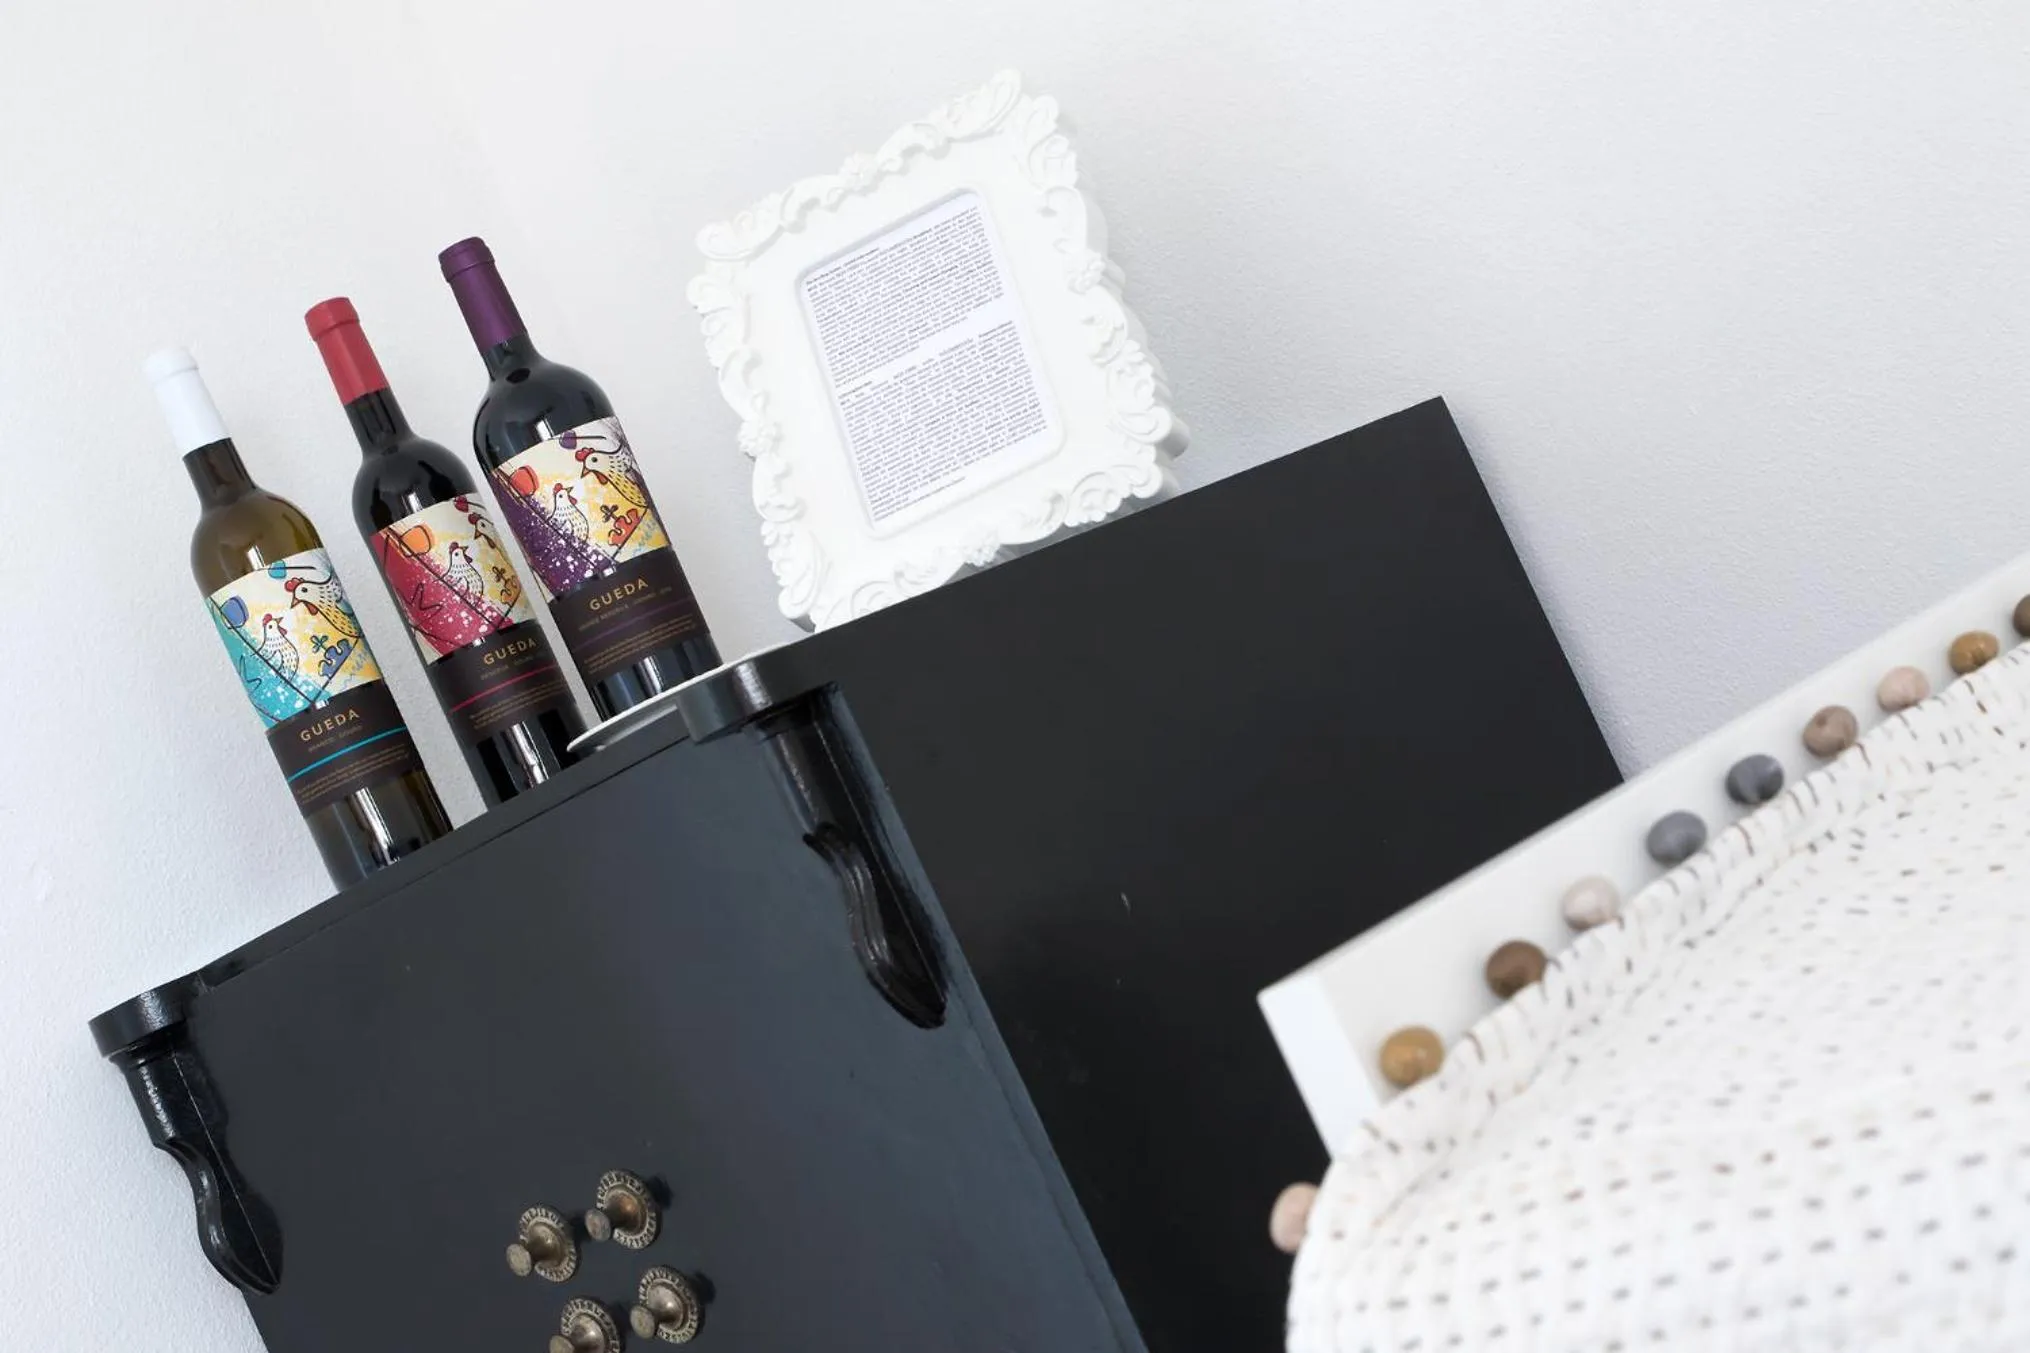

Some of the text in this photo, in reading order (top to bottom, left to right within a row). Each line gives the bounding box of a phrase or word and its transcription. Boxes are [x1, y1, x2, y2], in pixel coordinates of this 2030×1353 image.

[589, 578, 649, 611] GUEDA
[483, 637, 537, 665] GUEDA
[300, 708, 361, 741] GUEDA
